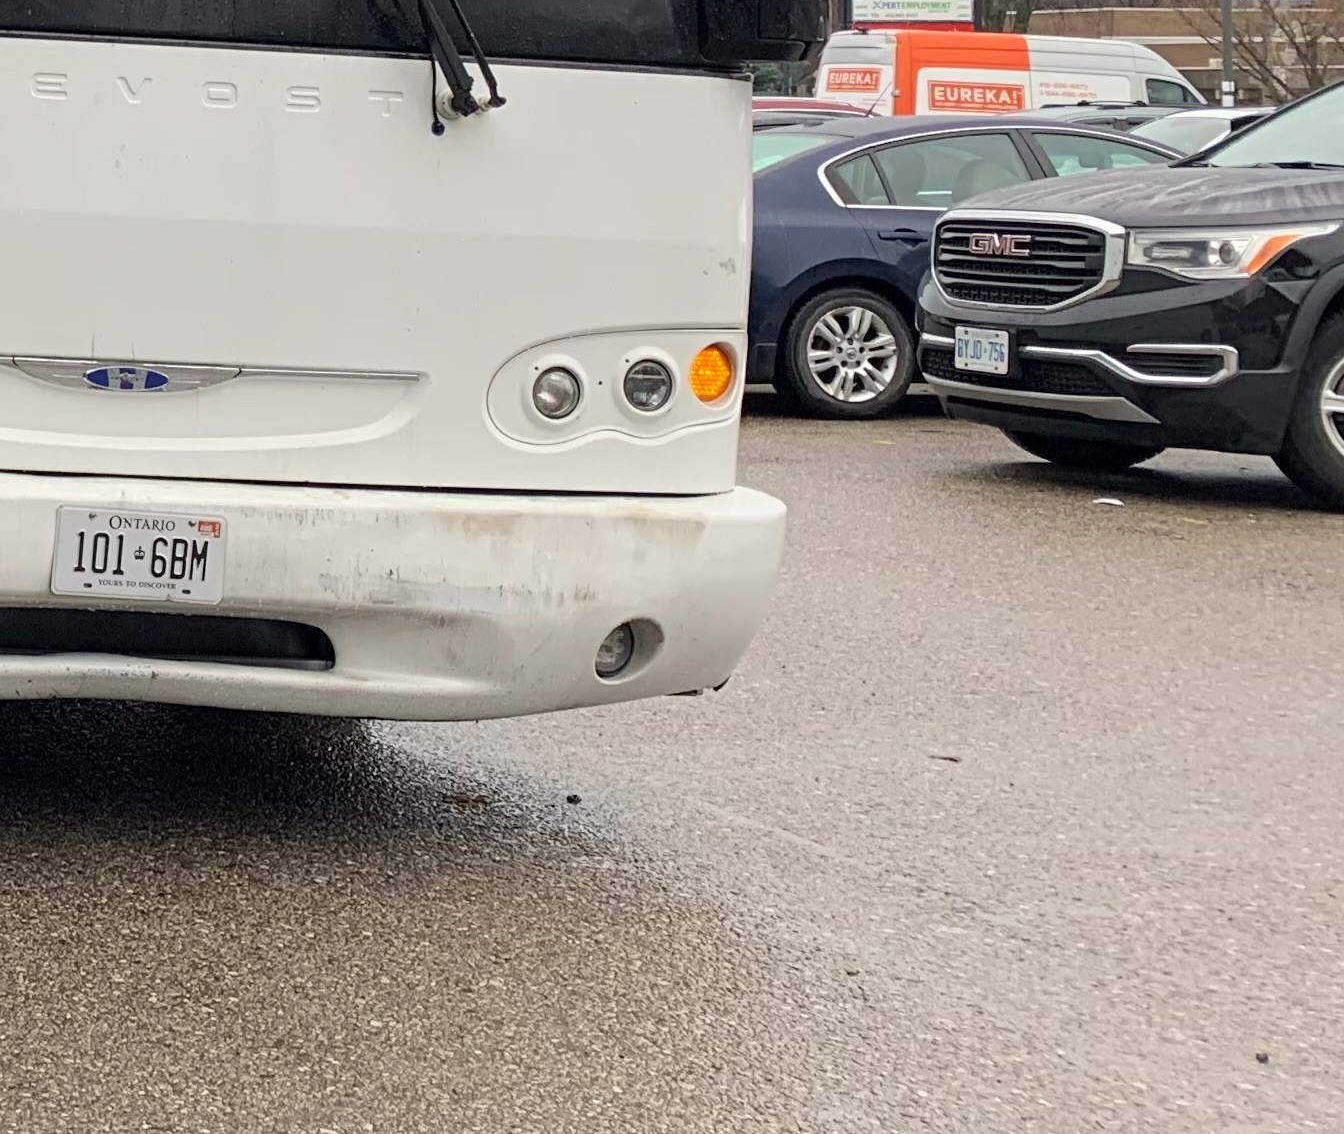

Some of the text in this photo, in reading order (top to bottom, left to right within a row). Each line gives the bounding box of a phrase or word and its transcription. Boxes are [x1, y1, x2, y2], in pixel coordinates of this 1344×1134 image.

[829, 71, 878, 85] EUREKA!
[934, 86, 1018, 105] EUREKA!
[969, 232, 1032, 256] GMC
[988, 341, 1005, 363] 756
[109, 515, 176, 533] ONTARIO
[73, 531, 209, 582] 101 6BM
[98, 579, 177, 590] YOURS TO DISCOVER
